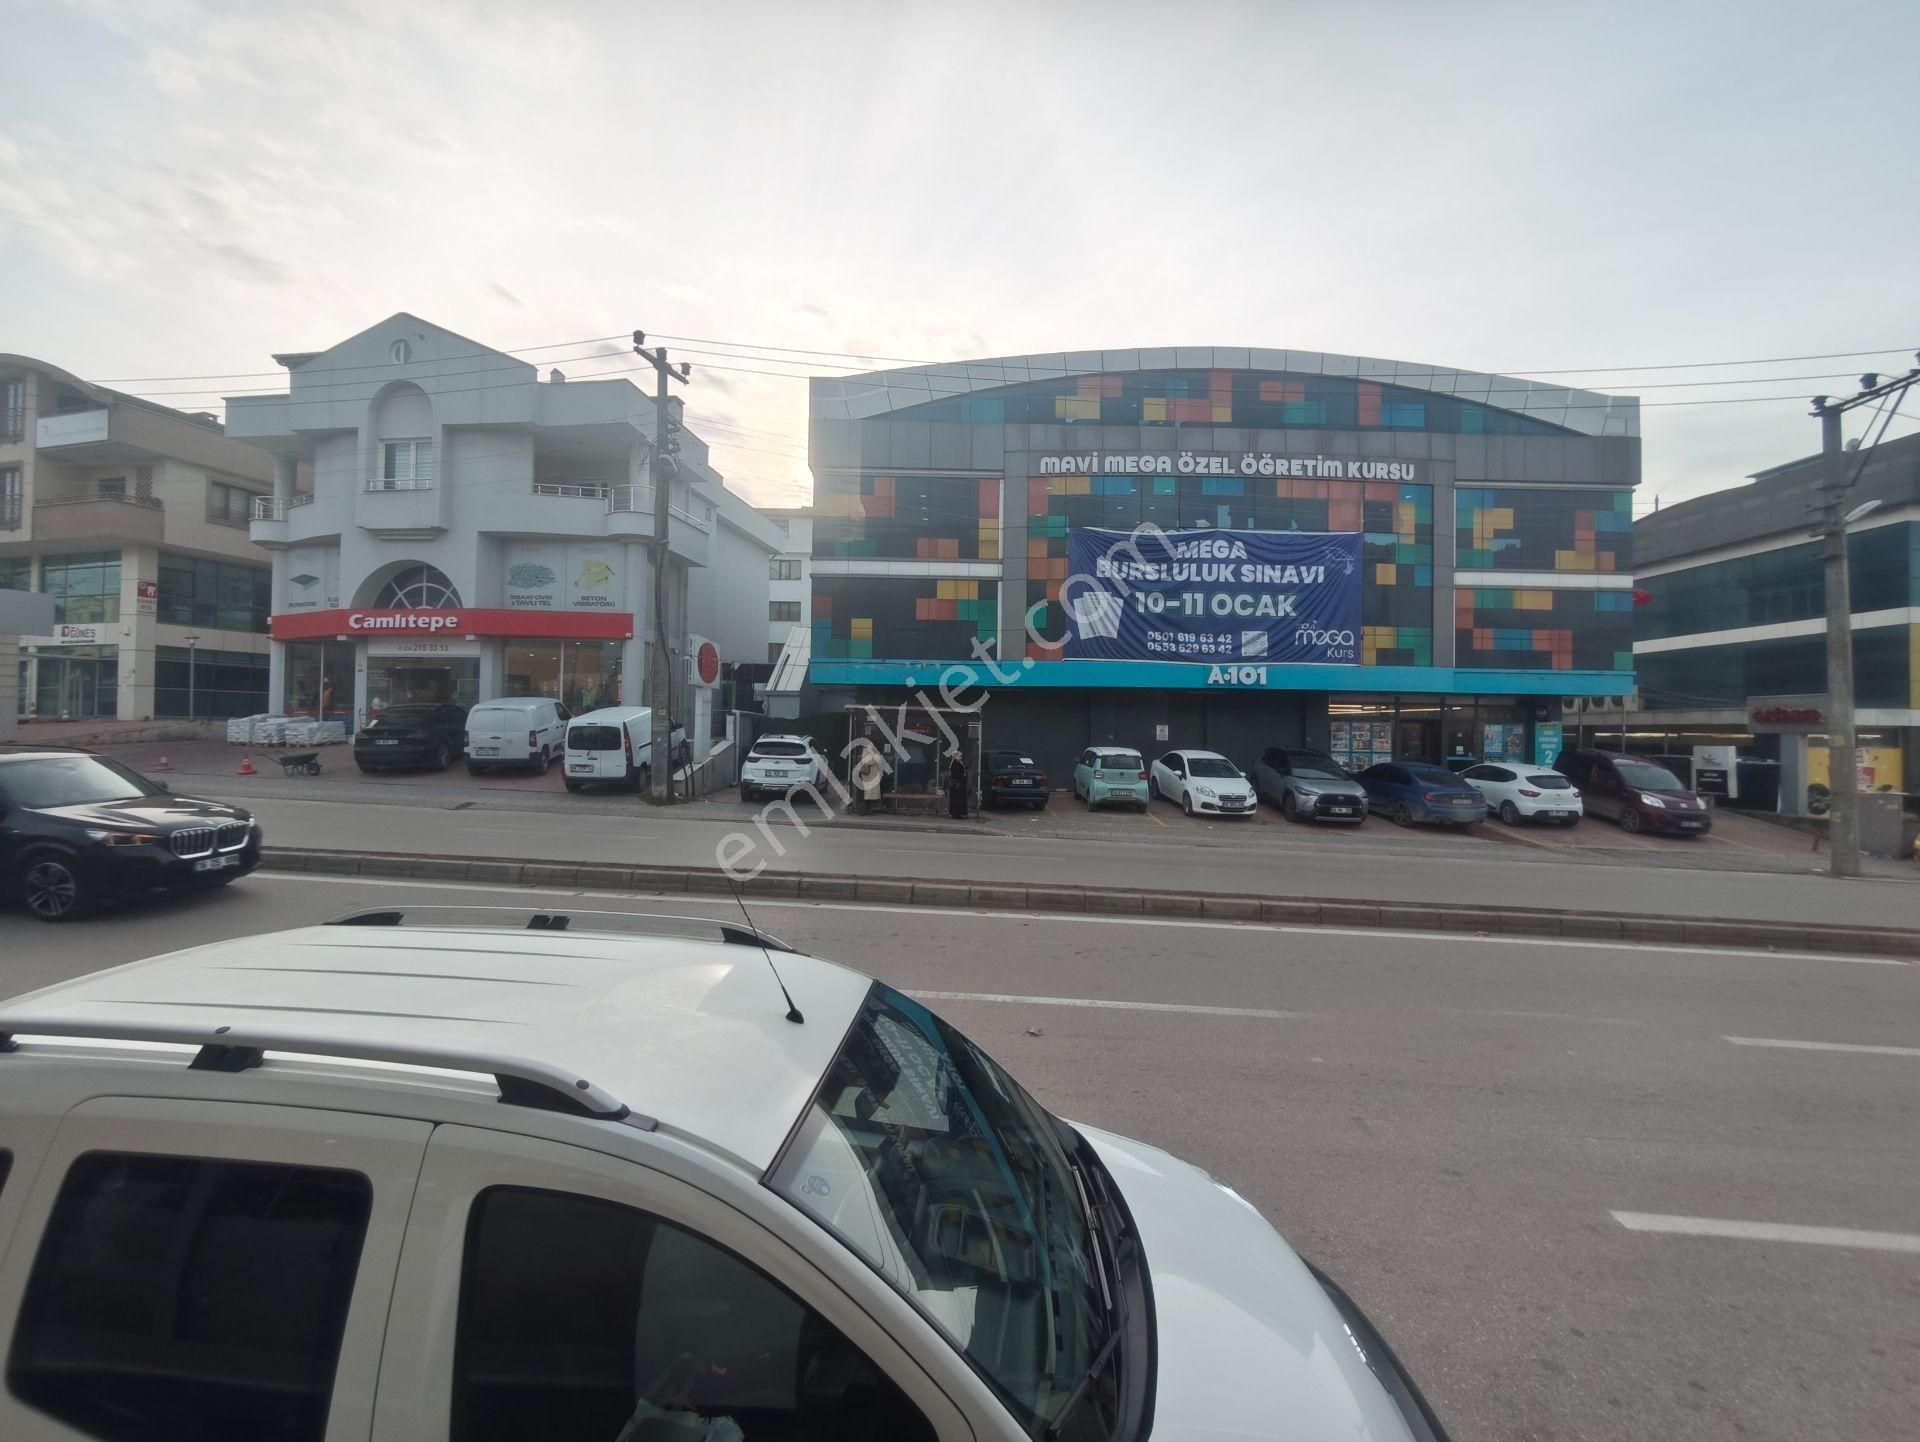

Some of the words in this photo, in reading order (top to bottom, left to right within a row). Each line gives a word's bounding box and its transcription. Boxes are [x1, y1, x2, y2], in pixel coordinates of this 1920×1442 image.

[1039, 451, 1099, 474] MAVİ
[1104, 455, 1172, 474] MEGA
[1177, 451, 1236, 474] ÖZEL
[1240, 452, 1343, 478] ÖĞRETİM
[1347, 461, 1416, 481] KURSU
[1176, 539, 1248, 559] MEGA
[1096, 555, 1236, 583] BURSLULUK
[1240, 563, 1326, 584] SINAVI
[1210, 593, 1298, 617] OCAK
[1199, 633, 1214, 643] 63
[1217, 633, 1232, 644] 42
[1201, 644, 1216, 654] 63
[1217, 644, 1232, 655] 42
[1327, 647, 1355, 659] Kurs
